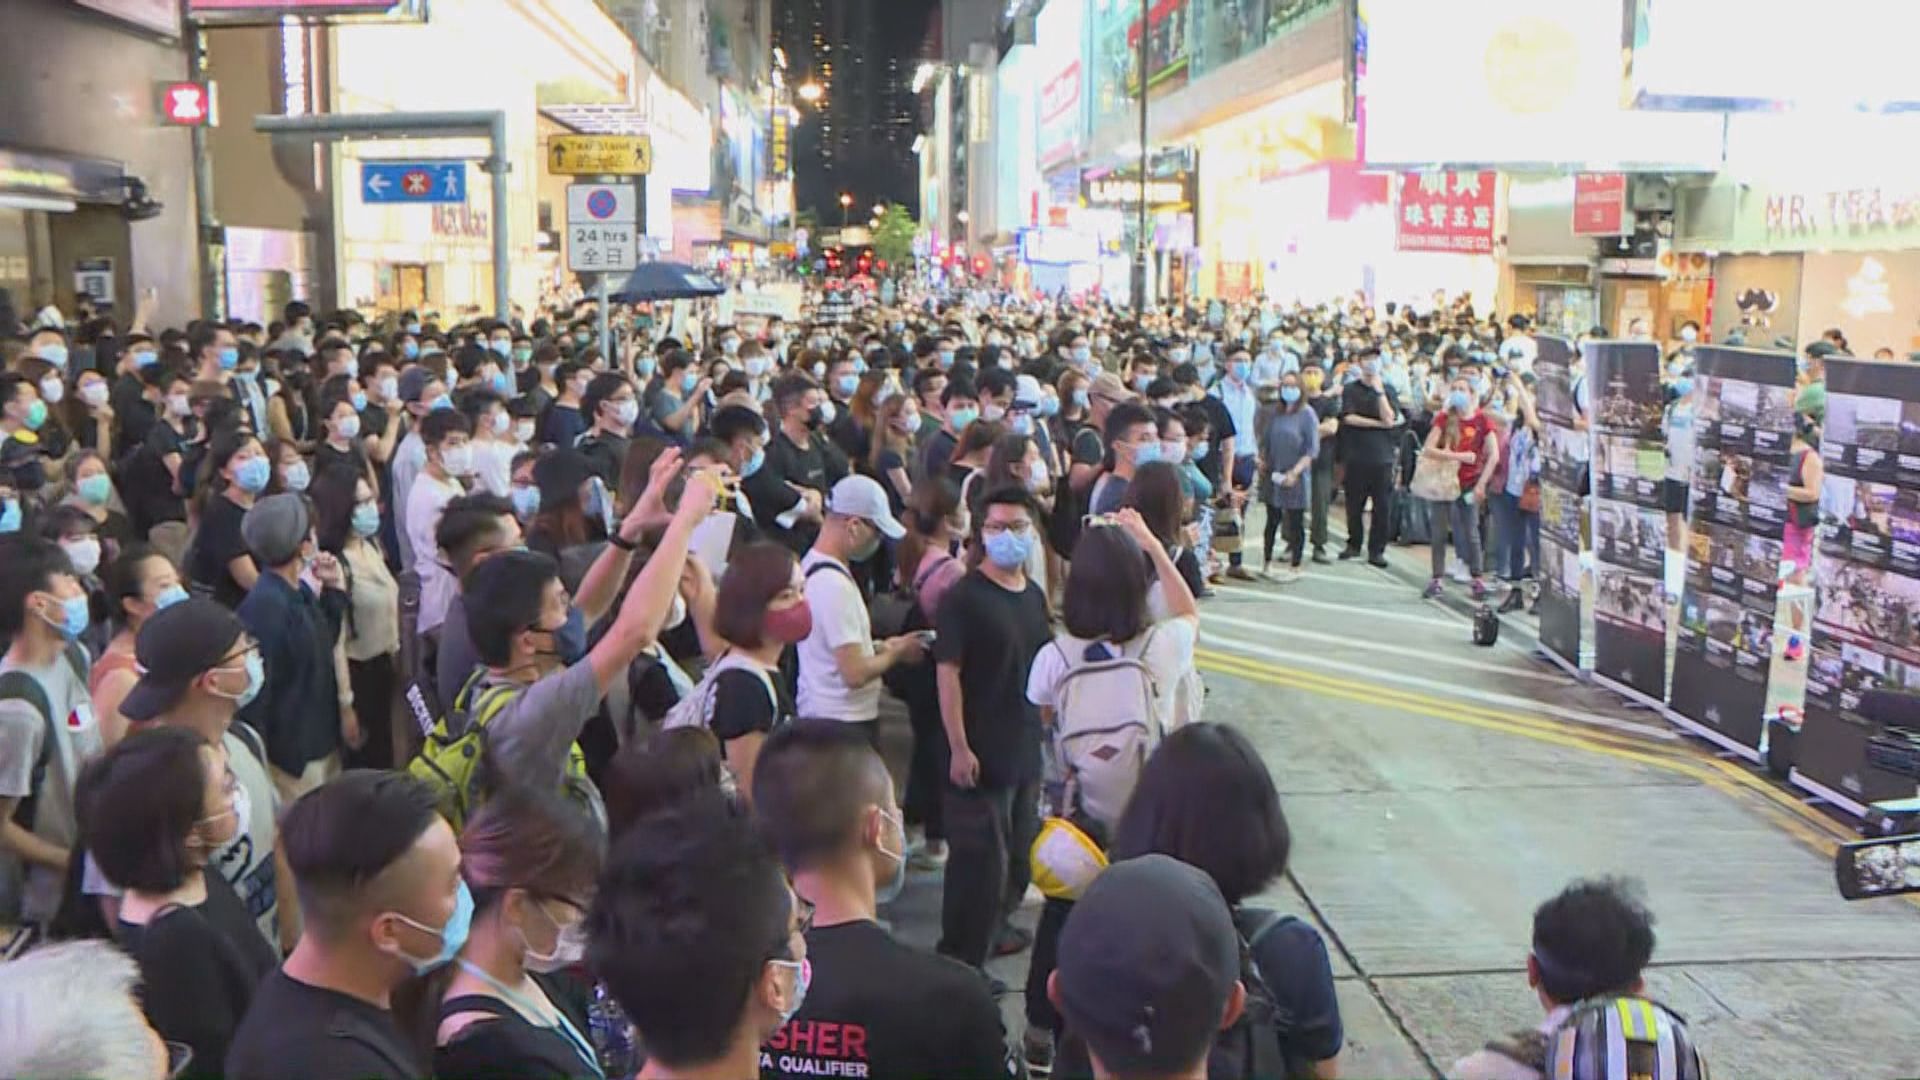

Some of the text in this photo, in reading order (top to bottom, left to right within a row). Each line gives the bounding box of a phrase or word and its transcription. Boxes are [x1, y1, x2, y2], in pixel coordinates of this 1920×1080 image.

[576, 229, 628, 243] 24 hrs
[582, 247, 623, 265] 全日
[780, 1055, 869, 1077] QUALIFIER
